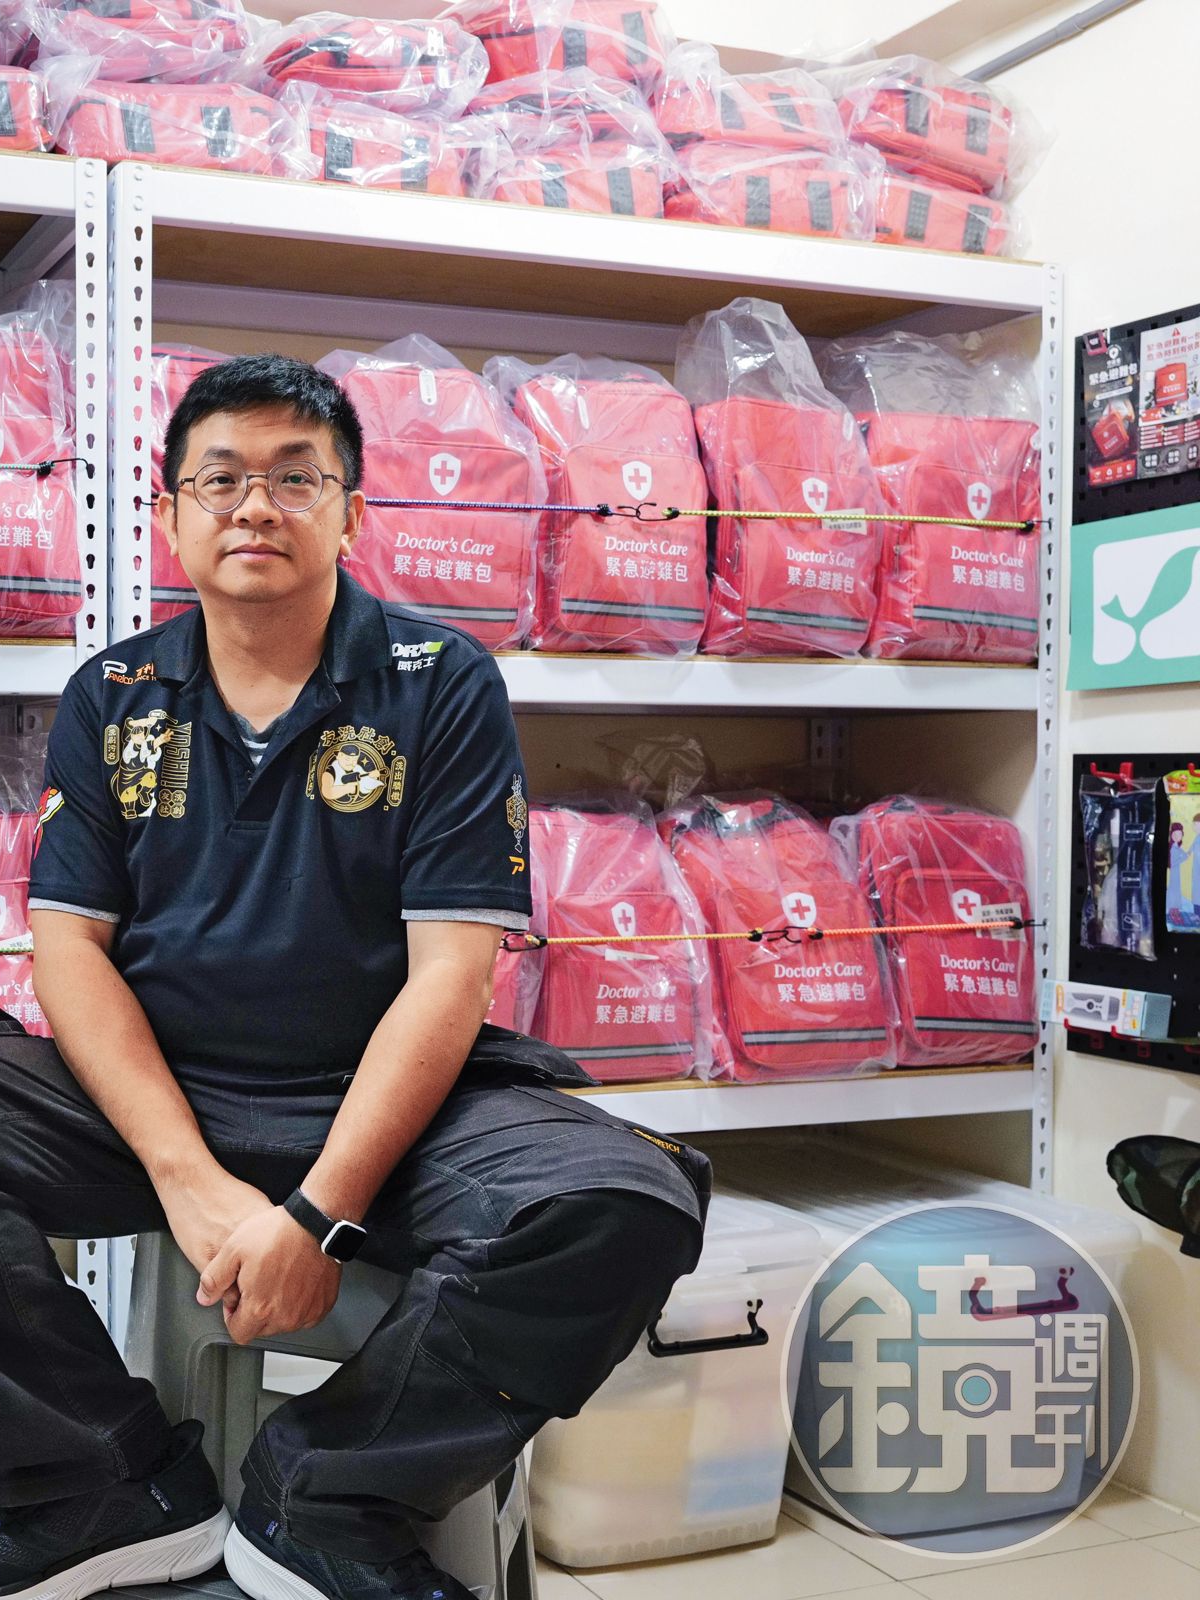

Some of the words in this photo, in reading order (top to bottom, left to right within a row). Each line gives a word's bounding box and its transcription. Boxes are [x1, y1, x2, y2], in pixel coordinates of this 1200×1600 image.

[395, 532, 459, 553] Doctor's
[461, 538, 495, 557] Care
[605, 536, 658, 556] Doctor's
[660, 540, 688, 557] Care
[392, 554, 492, 584] 緊急避難包
[786, 546, 835, 565] Doctor's
[836, 551, 856, 569] Care
[951, 546, 999, 566] Doctor's
[1001, 551, 1025, 569] Care
[605, 556, 689, 583] 緊急避難包
[786, 565, 855, 594] 緊急避難包
[952, 565, 1025, 593] 緊急避難包
[397, 656, 436, 671] 威克士
[321, 725, 395, 755] 友洗社創
[774, 963, 831, 978] Doctor's
[834, 962, 864, 977] Care
[940, 954, 990, 972] Doctor's
[991, 957, 1016, 973] Care
[596, 984, 649, 1000] Doctor's
[777, 982, 866, 1003] 緊急避難包
[943, 973, 1019, 997] 緊急避難包
[595, 1004, 677, 1025] 緊急避難包
